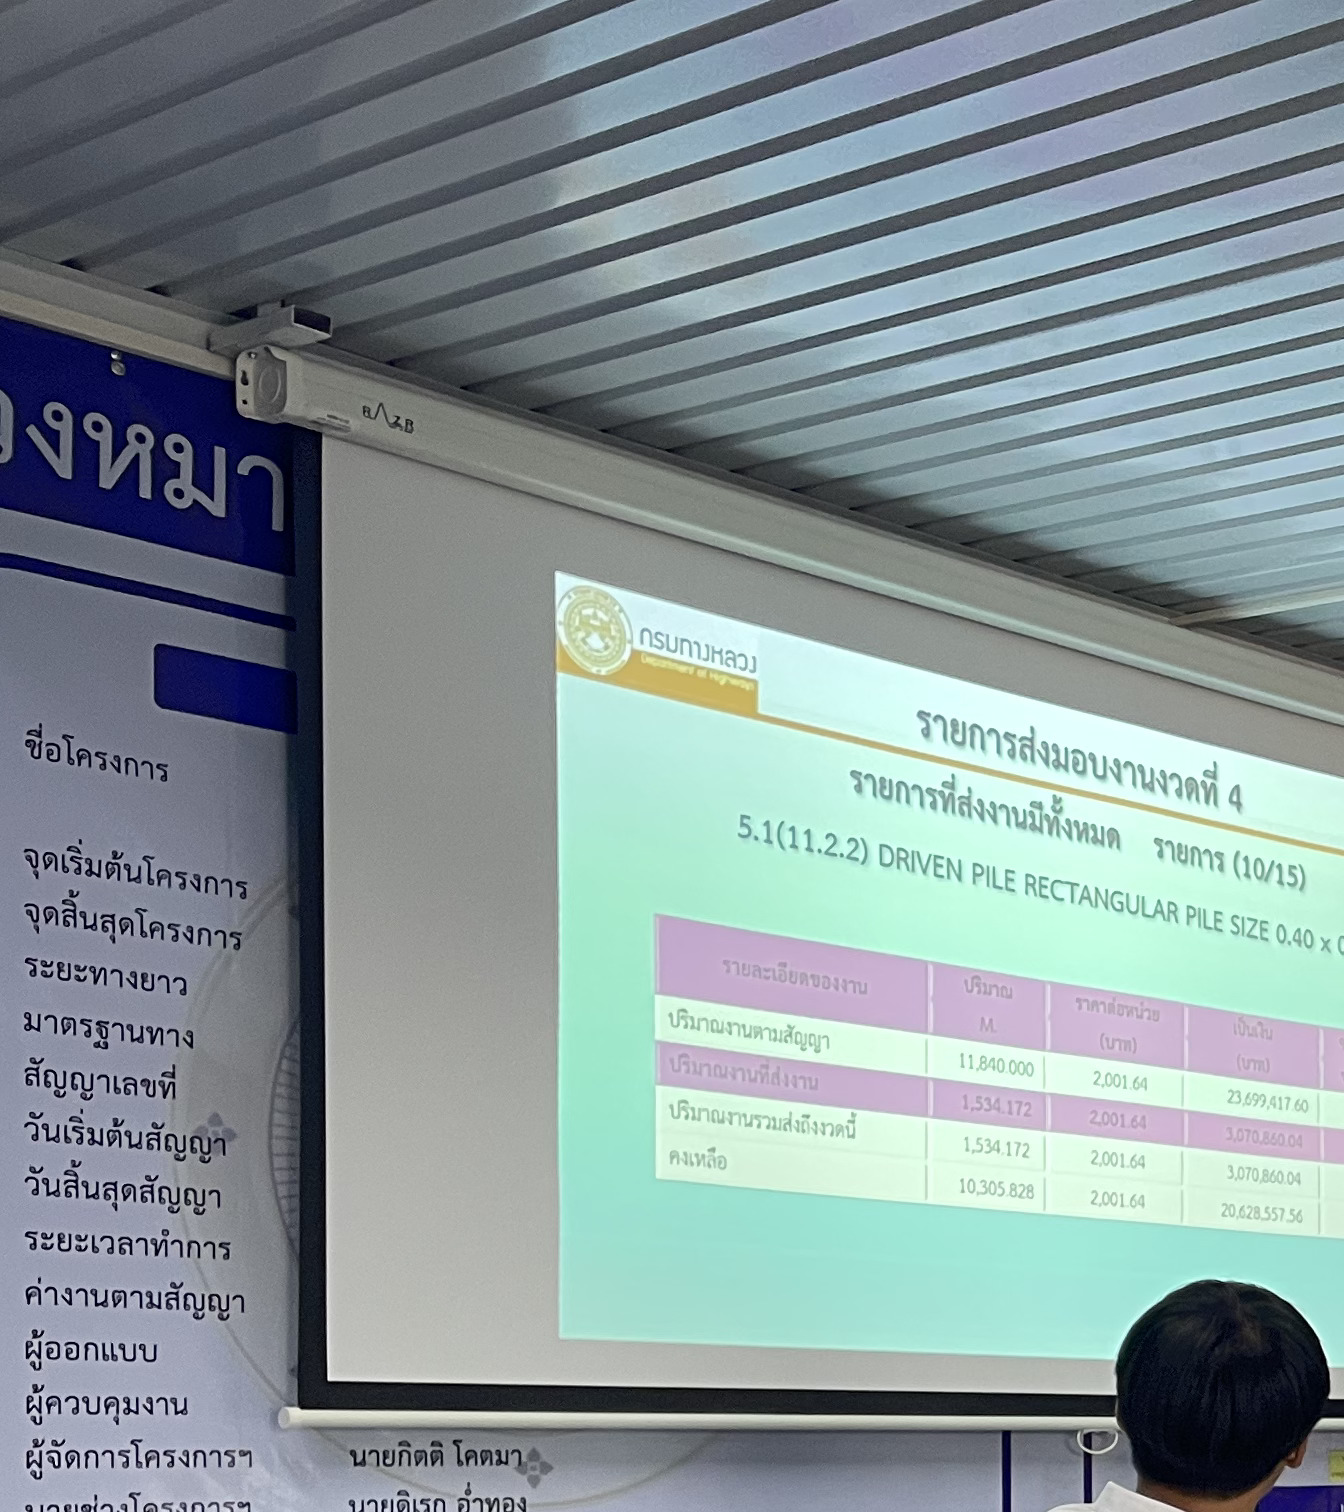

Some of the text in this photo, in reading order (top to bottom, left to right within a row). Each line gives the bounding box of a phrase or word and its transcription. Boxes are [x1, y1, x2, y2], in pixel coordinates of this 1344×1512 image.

[640, 626, 757, 674] กรมทางหลวง
[24, 724, 169, 784] ชื่อโครงการ
[918, 708, 1244, 812] รายการส่งมอบงานงวดที่ 4
[850, 767, 1306, 892] รายการที่ส่งงานมีทั้งหมด รายการ (10/15)
[23, 838, 248, 902] จุดเริ่มต้นโครงการ
[738, 814, 869, 866] 5.1(11.2.2)
[879, 844, 962, 884] DRIVEN
[972, 863, 1016, 893] PILE
[1024, 872, 1179, 925] RECTANGULAR
[1186, 905, 1223, 933] PILE
[1231, 914, 1269, 942] SIZE
[1276, 922, 1314, 951] 0.40
[1321, 936, 1332, 954] x
[23, 892, 243, 953] จุดสิ้นสุดโครงการ
[24, 954, 189, 997] ระยะทางยาว
[963, 975, 1013, 1000] ปริมาณ
[23, 1006, 195, 1054] มาตรฐานทาง
[1100, 1033, 1137, 1054] (บาท)
[24, 1057, 177, 1101] สัญญาเลขที่
[668, 1008, 829, 1053] ปริมาณงานตามสัญญา
[960, 1053, 1034, 1077] 11,840.000
[1093, 1071, 1148, 1092] 2,001.64
[1227, 1089, 1309, 1113] 23,699,417.60
[23, 1108, 227, 1164] วันเริ่มต้นสัญญา
[962, 1094, 1032, 1117] 1,534.172
[1089, 1110, 1147, 1130] 2,001.64
[964, 1136, 1030, 1159] 1,534.172
[1090, 1150, 1146, 1169] 2,001.64
[1227, 1165, 1301, 1186] 3,070,860.04
[24, 1160, 222, 1216] วันสิ้นสุดสัญญา
[669, 1147, 727, 1171] คงเหลือ
[959, 1178, 1035, 1200] 10,305.828
[1090, 1190, 1145, 1209] 2,001.64
[1221, 1203, 1304, 1224] 20,628,557.56
[24, 1228, 232, 1262] ระยะเวลาทำการ
[25, 1277, 246, 1321] ค่างานตามสัญญา
[25, 1329, 158, 1370] ผู้ออกแบบ
[25, 1384, 189, 1426] ผู้ควบคุมงาน
[25, 1439, 524, 1480] ผู้จัดการโครงการฯ นายกิตติ โคตมา
